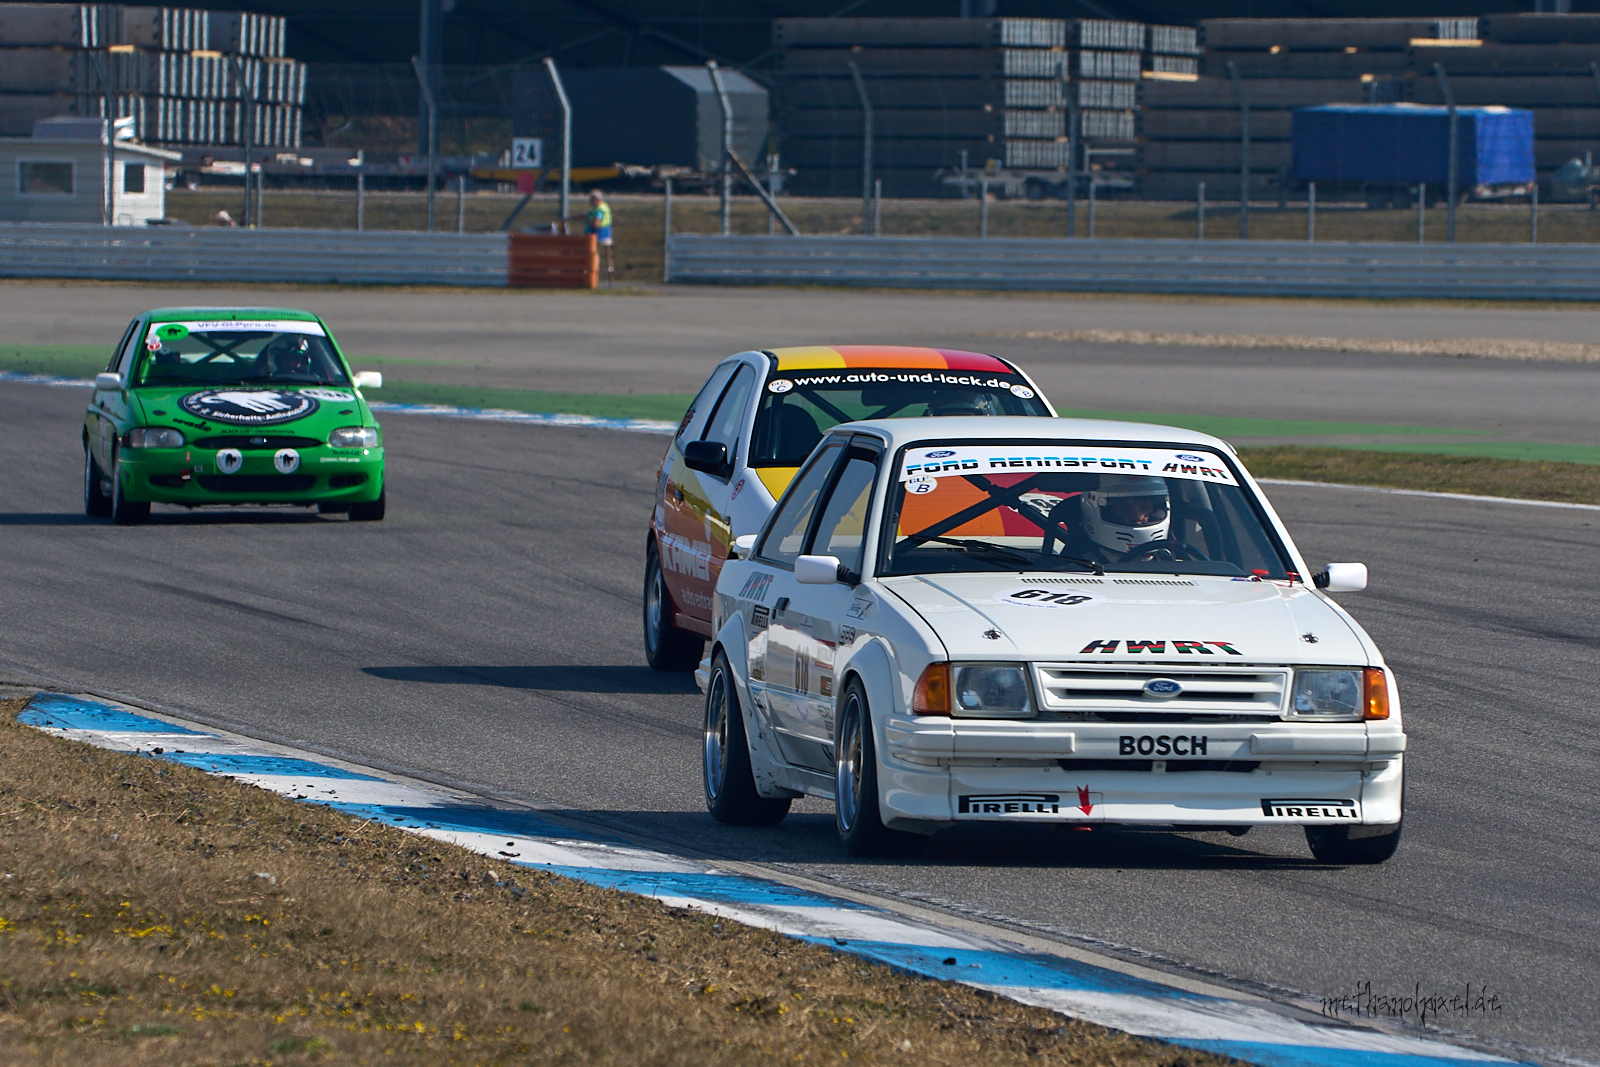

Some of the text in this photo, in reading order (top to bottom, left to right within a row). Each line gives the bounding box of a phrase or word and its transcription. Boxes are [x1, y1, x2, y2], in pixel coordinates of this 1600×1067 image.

[516, 142, 536, 162] 24
[794, 372, 1011, 390] www.auto-und-lack.de
[906, 456, 1153, 475] FORD RENNSPORT
[1161, 462, 1229, 479] HWRT
[915, 484, 930, 493] B
[661, 531, 712, 582] KAMEI
[738, 570, 774, 602] HWRT
[1009, 589, 1093, 605] 618
[751, 604, 770, 629] PIRELLI
[1079, 639, 1243, 656] HWRT
[795, 643, 810, 696] 618
[1118, 735, 1208, 756] BOSCH
[958, 793, 1060, 814] PIRELLI
[1260, 798, 1358, 818] PIRELLI
